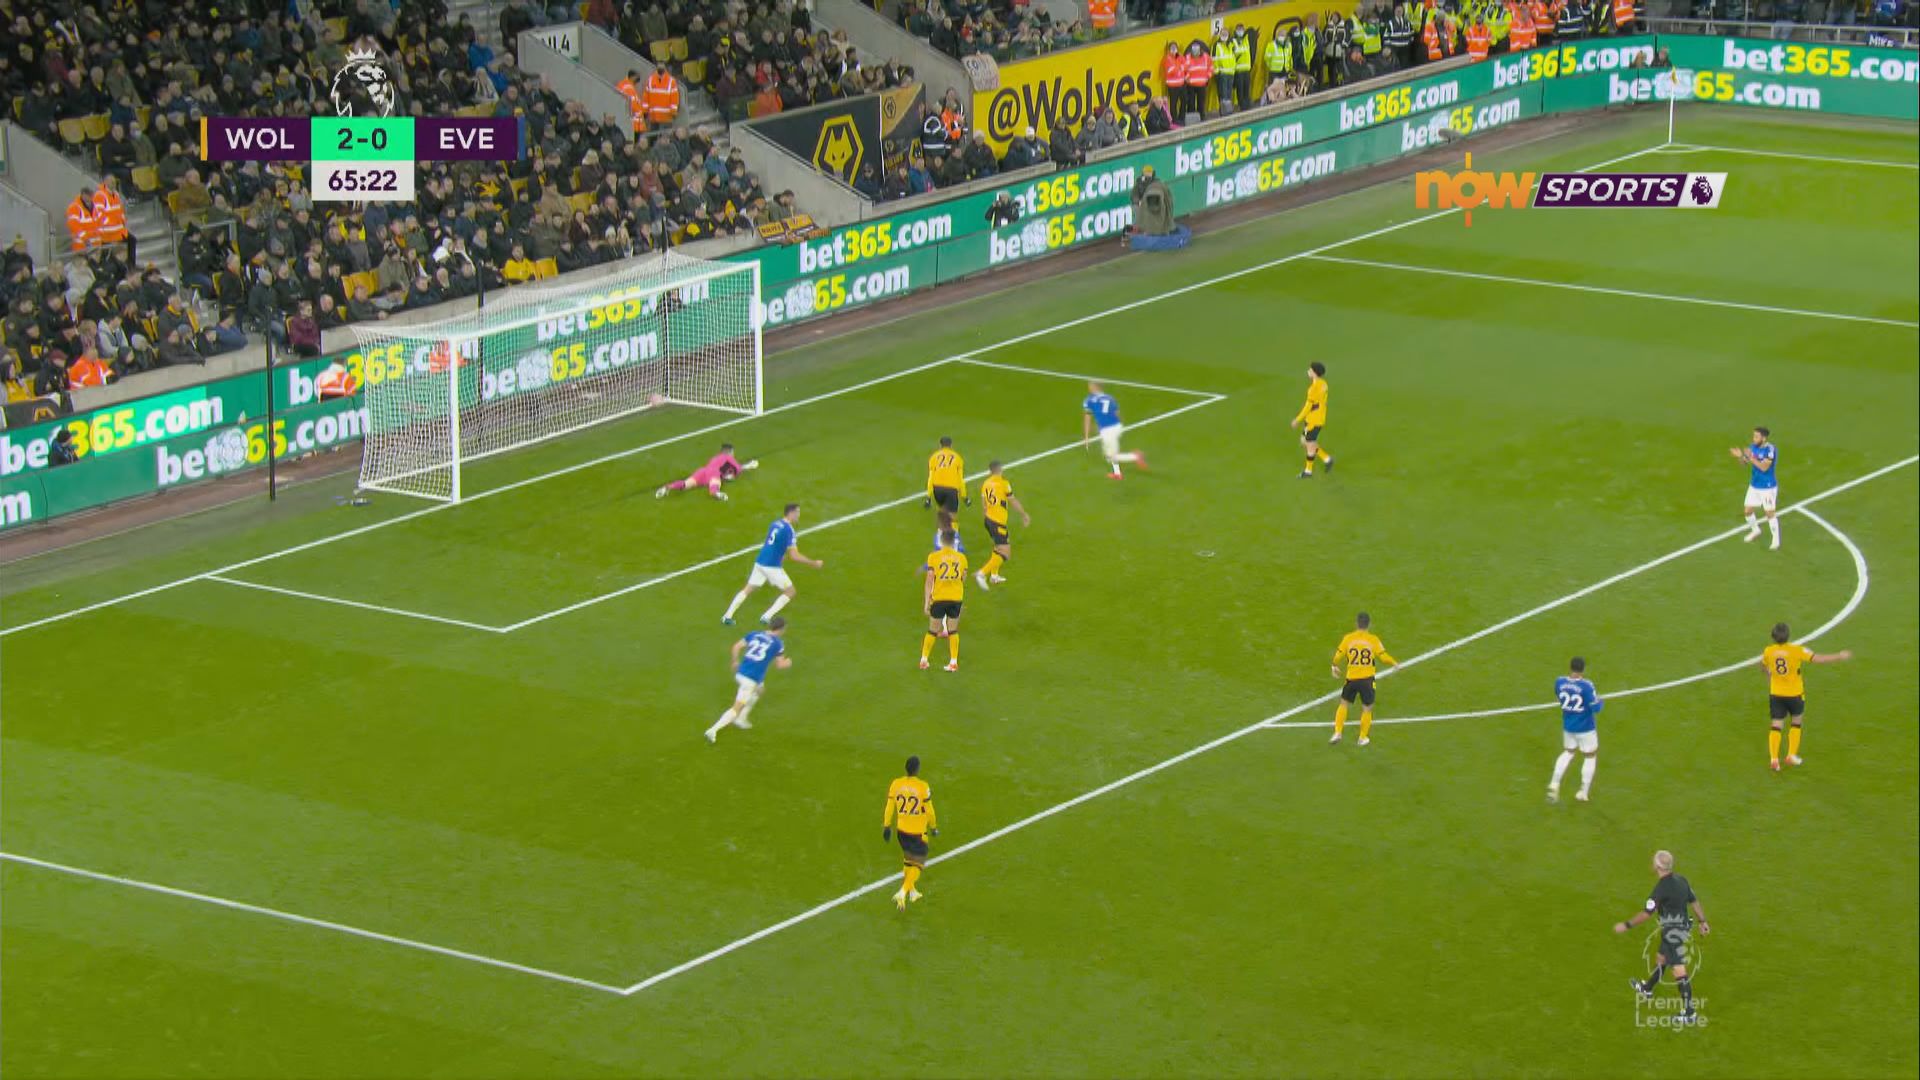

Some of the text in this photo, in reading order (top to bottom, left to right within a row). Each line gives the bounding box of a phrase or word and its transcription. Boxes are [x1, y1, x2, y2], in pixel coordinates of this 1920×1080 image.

[1493, 45, 1655, 88] bet365.com
[988, 67, 1152, 142] @Wolves
[1340, 80, 1459, 131] bet365.com
[1609, 69, 1820, 109] bet65.com
[1401, 98, 1520, 151] bet65.com
[1175, 122, 1303, 177] bet365.com
[996, 166, 1135, 217] et365.com
[1206, 151, 1336, 206] bet65.com
[800, 214, 952, 274] bet365.com
[990, 205, 1133, 264] bet65.com
[1100, 399, 1110, 413] 7
[156, 406, 368, 485] bet65.com
[937, 454, 955, 468] 27
[985, 487, 997, 506] 16
[767, 527, 779, 546] 5
[939, 561, 960, 580] 23
[745, 639, 771, 662] 23
[1349, 647, 1372, 666] 28
[1775, 657, 1787, 675] 8
[1558, 691, 1585, 712] 22
[896, 794, 919, 815] 22
